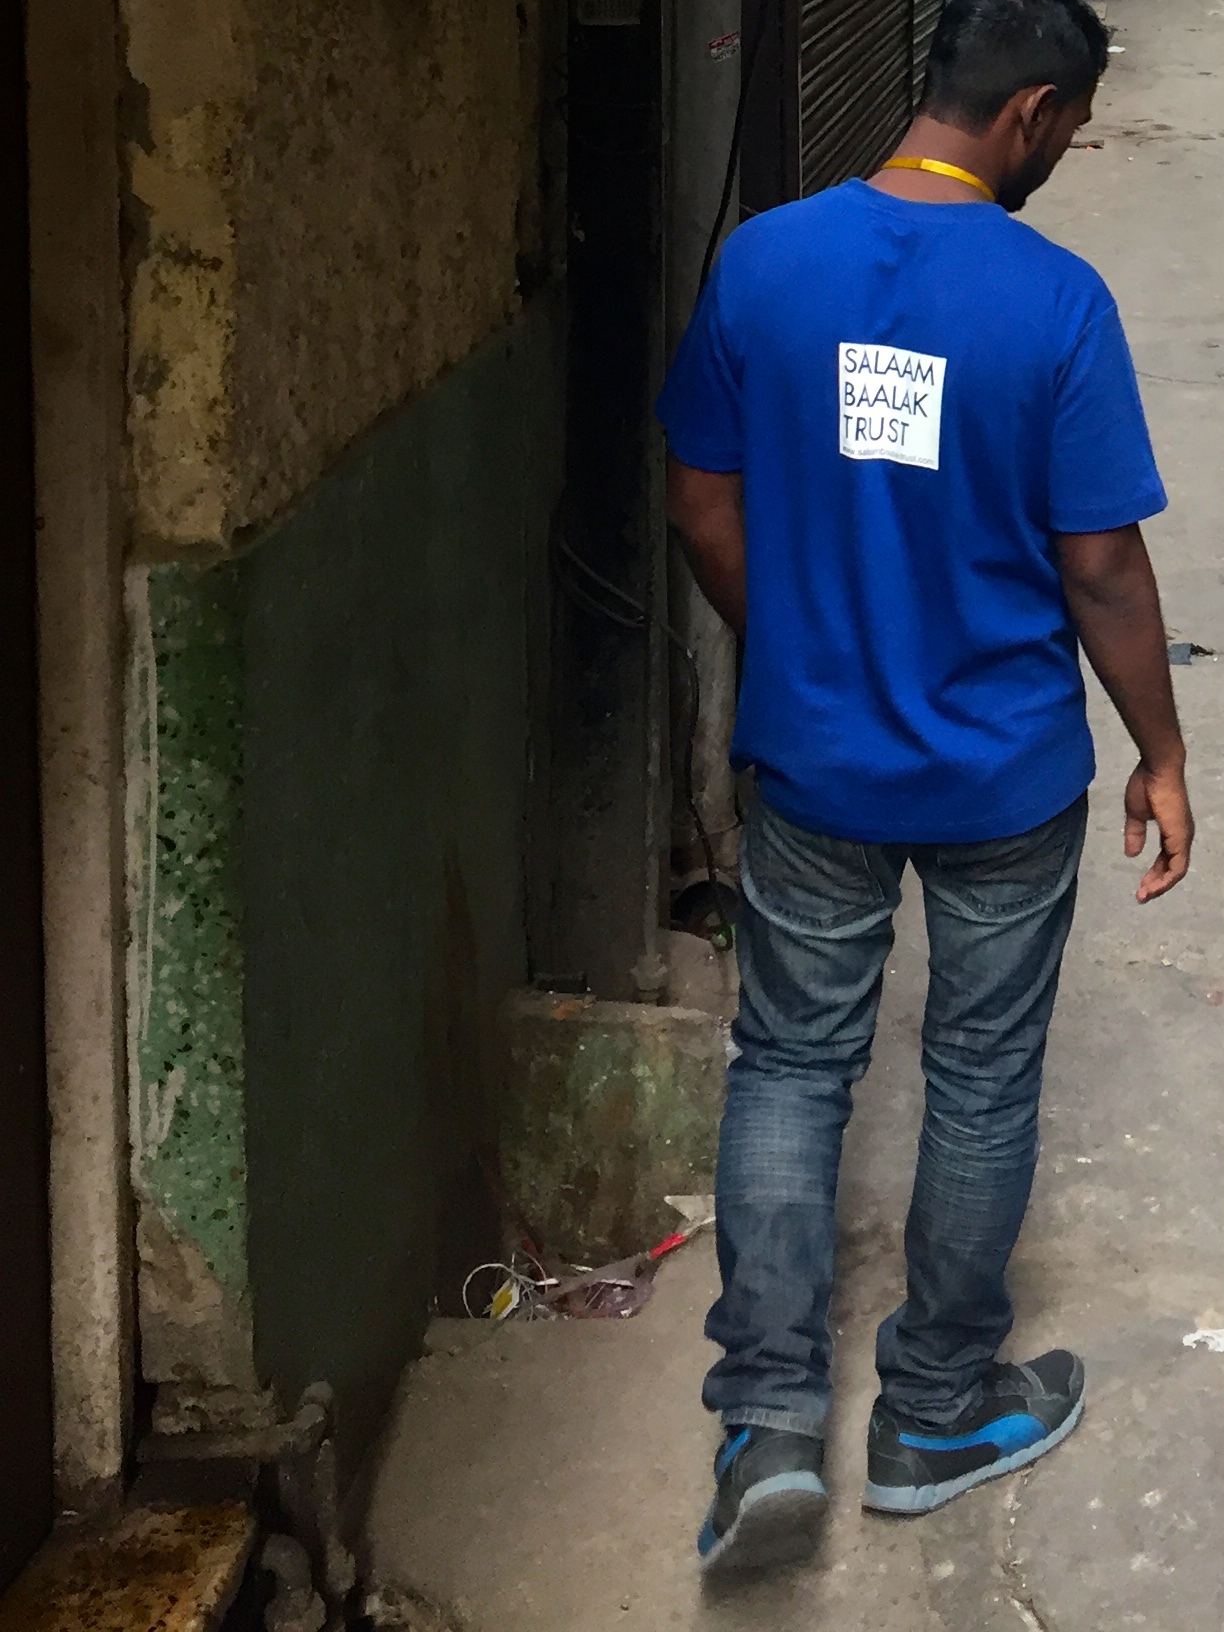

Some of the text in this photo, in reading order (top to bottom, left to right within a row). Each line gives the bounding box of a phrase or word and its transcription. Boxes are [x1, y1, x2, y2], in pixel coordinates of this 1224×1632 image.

[844, 347, 935, 386] SALAAM
[844, 381, 929, 418] BAALAK
[843, 414, 910, 446] TRUST
